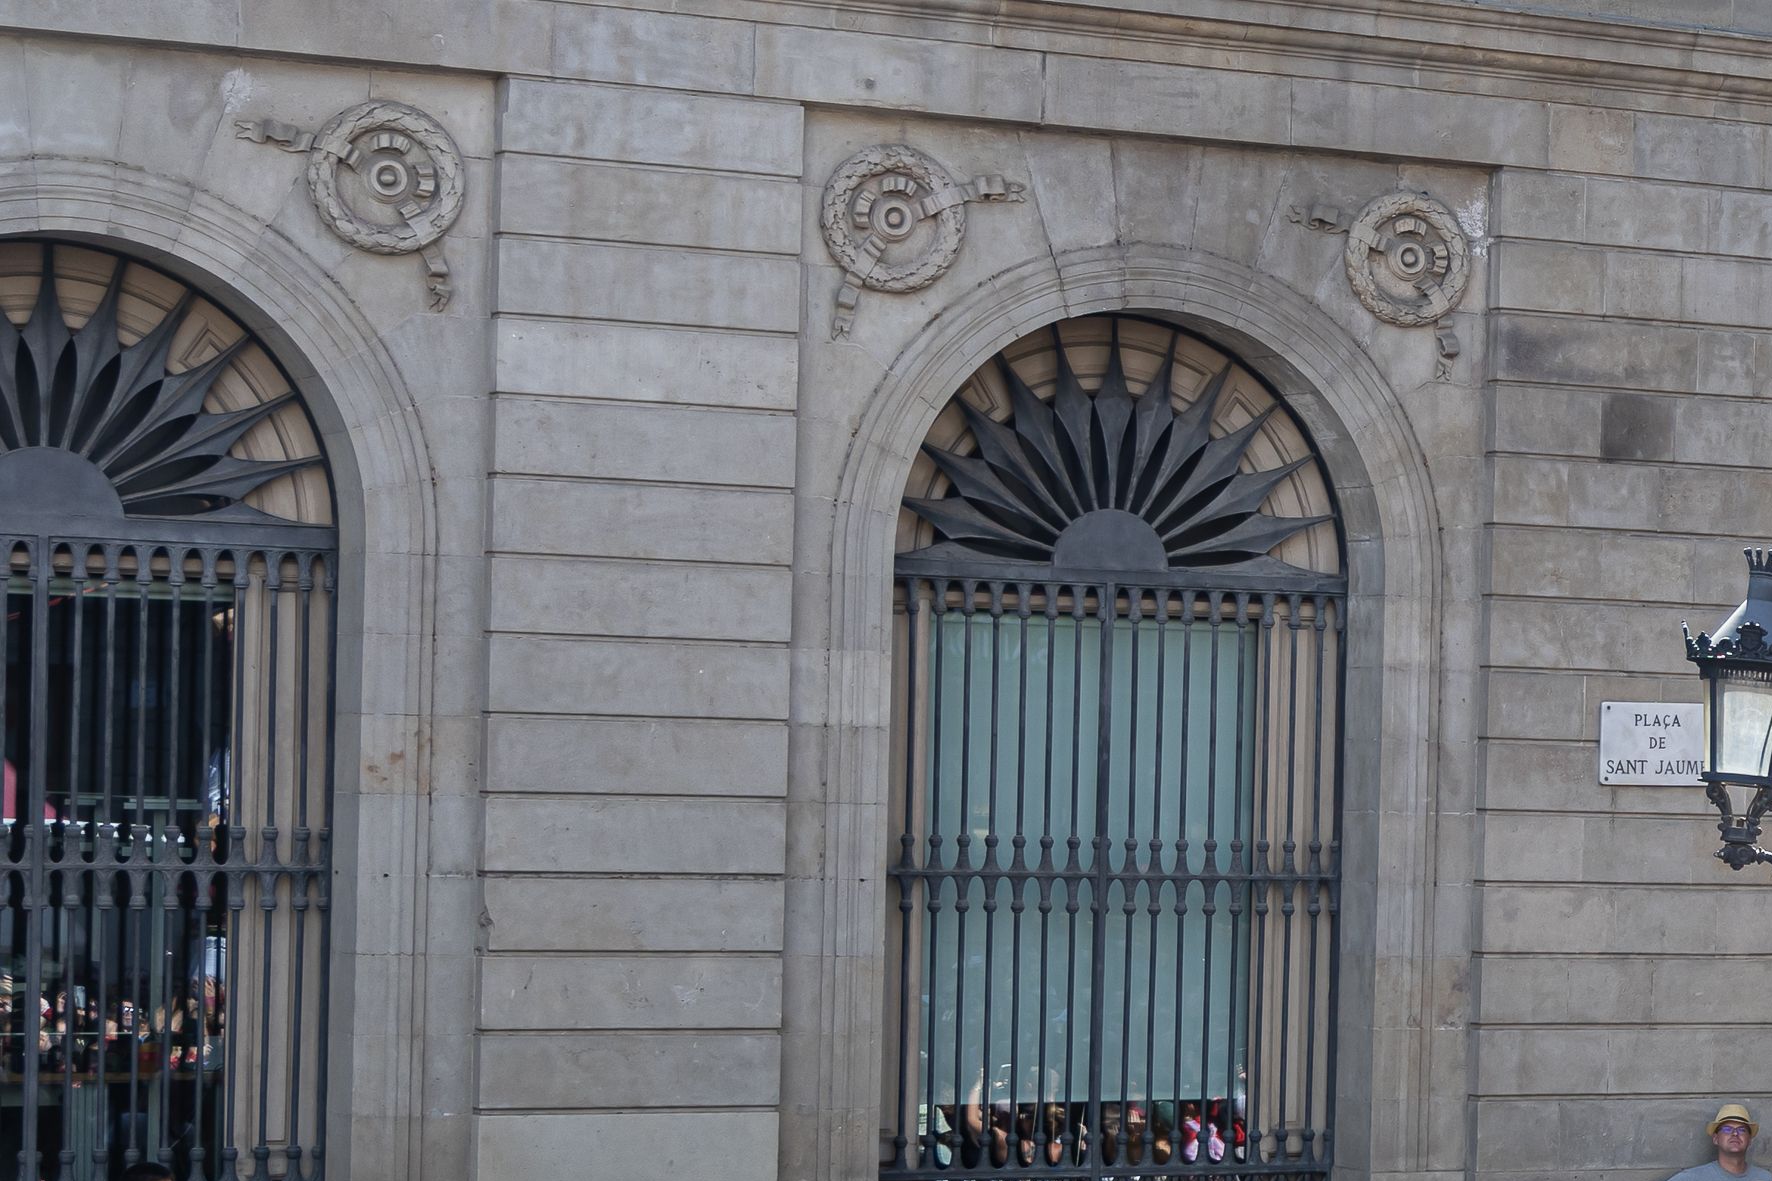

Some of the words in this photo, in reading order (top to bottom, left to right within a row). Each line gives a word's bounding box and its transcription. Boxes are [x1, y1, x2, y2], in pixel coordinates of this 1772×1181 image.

[1634, 713, 1681, 729] PLAÇA
[1649, 736, 1666, 749] DE
[1606, 759, 1648, 775] SANT
